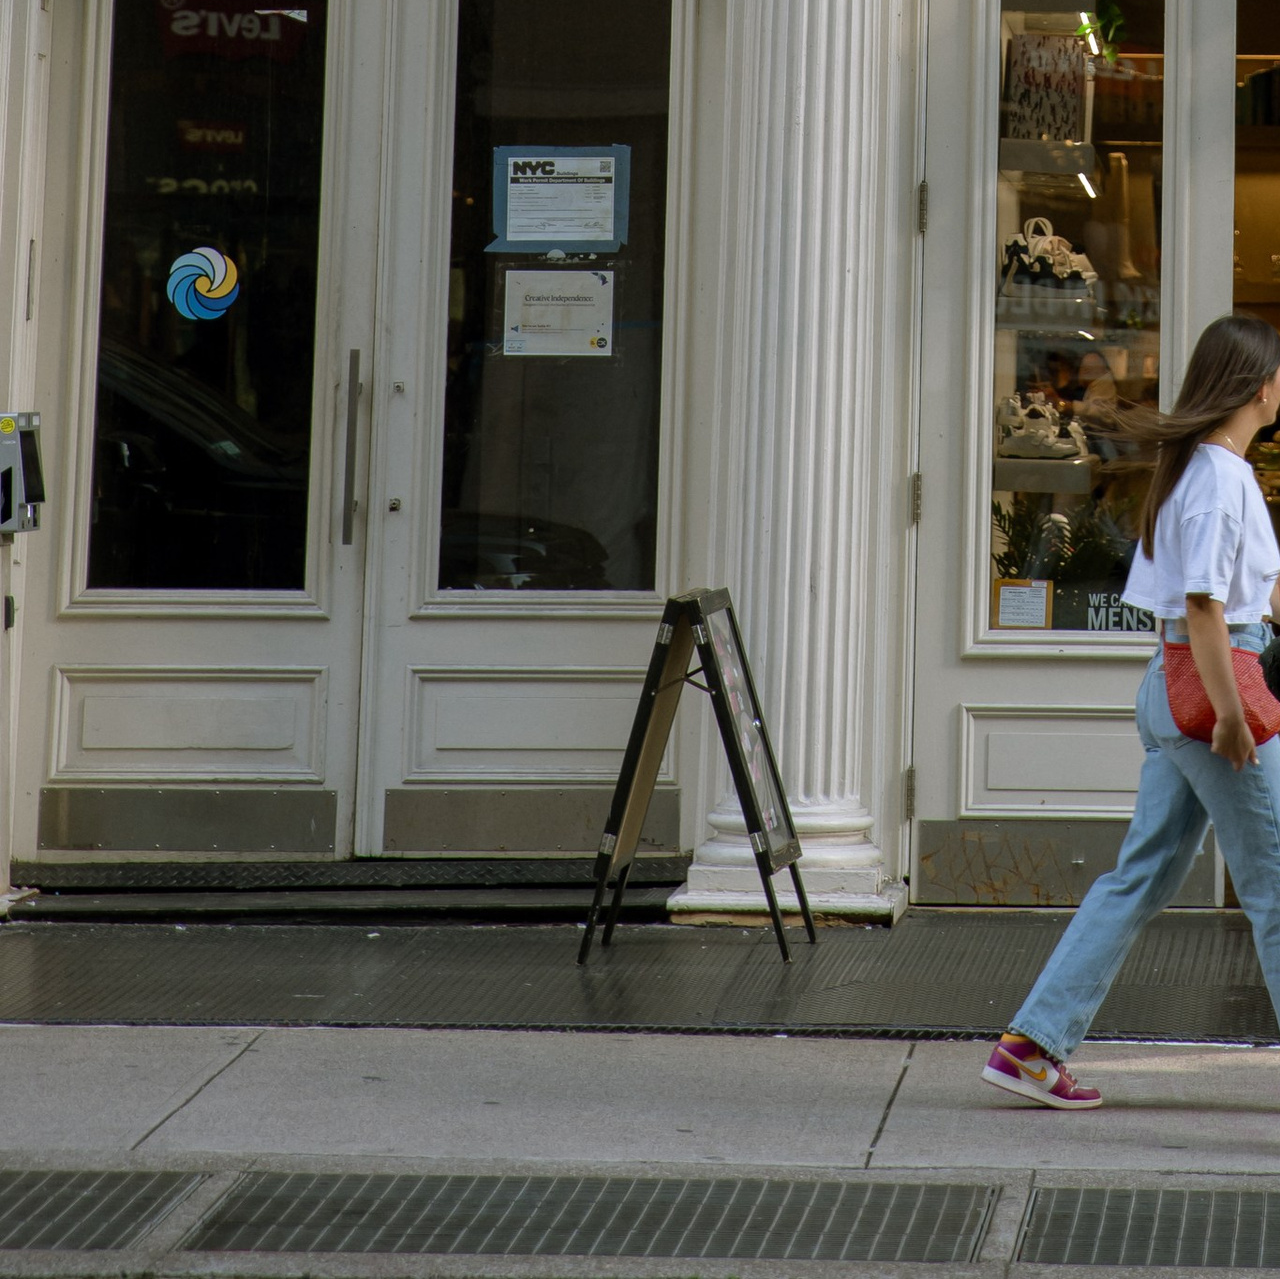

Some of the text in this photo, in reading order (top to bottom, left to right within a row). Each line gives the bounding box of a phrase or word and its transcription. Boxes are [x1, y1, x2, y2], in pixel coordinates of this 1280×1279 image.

[512, 160, 555, 176] NYC
[524, 294, 551, 302] Creative
[1088, 593, 1108, 607] WE
[1087, 607, 1153, 631] MENS
